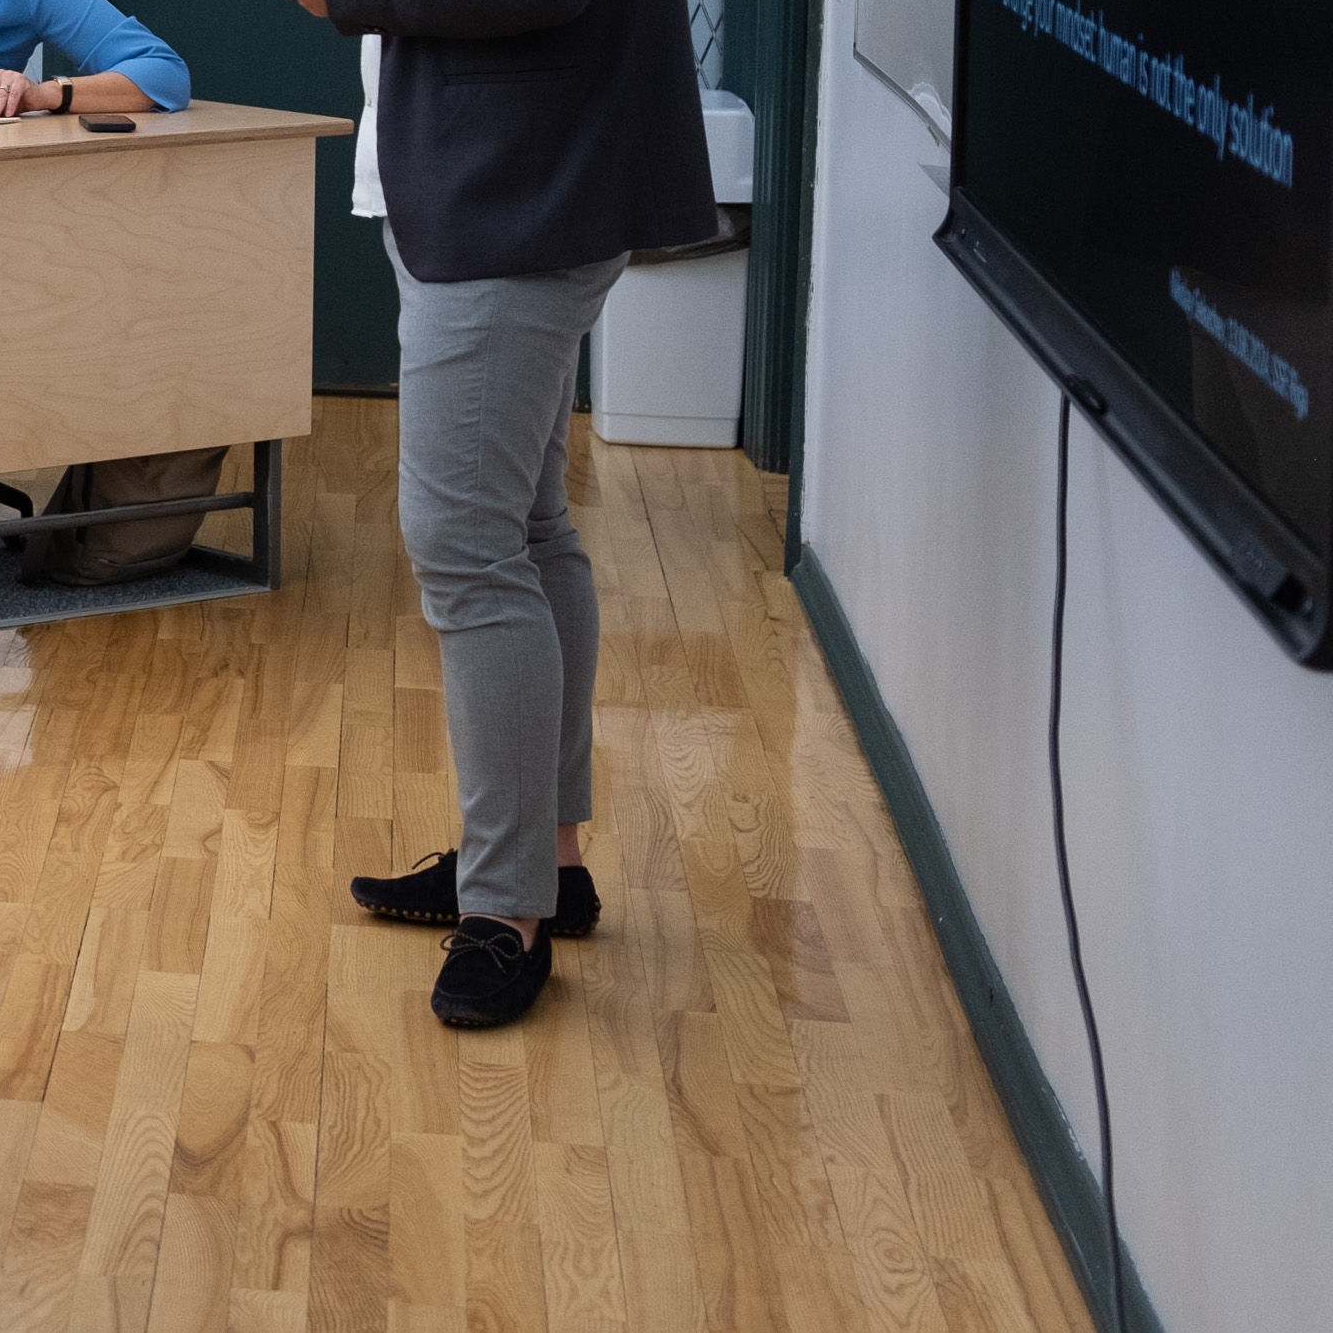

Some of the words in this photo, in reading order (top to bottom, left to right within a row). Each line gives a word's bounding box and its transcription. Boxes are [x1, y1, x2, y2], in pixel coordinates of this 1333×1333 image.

[1098, 12, 1136, 86] human
[1136, 35, 1148, 96] is
[1149, 55, 1171, 111] not
[1171, 56, 1195, 126] the
[1195, 75, 1229, 160] only
[1228, 93, 1293, 188] solution
